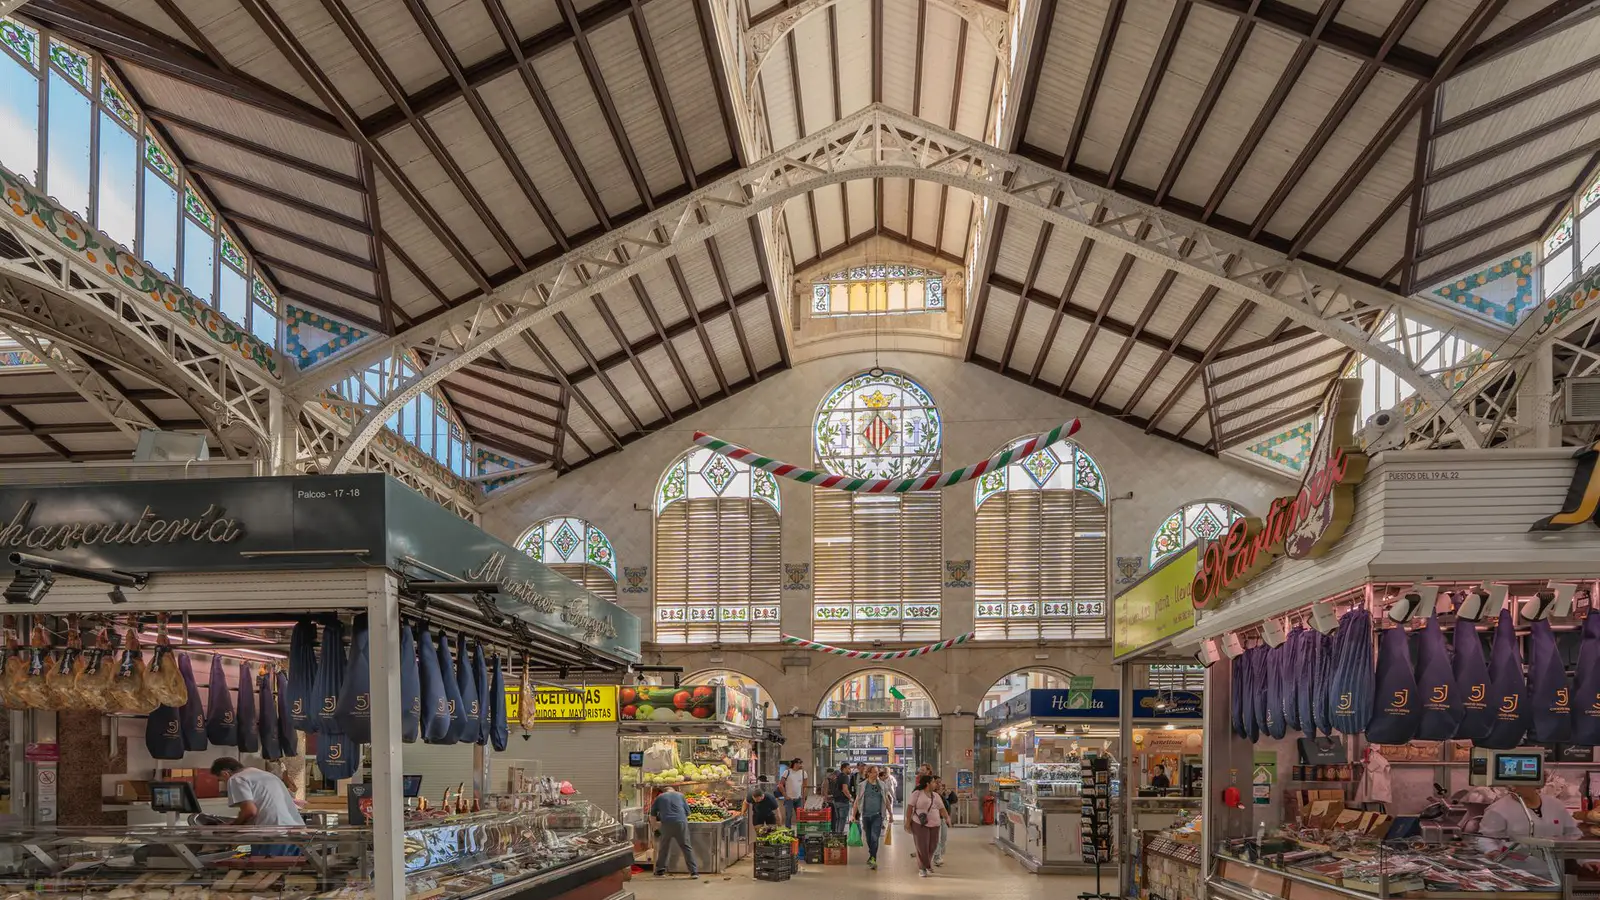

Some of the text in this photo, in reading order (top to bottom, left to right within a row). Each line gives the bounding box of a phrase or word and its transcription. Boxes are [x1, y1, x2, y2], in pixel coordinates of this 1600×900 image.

[1389, 472, 1416, 480] PUESTOS
[1418, 472, 1429, 480] DEL
[1431, 472, 1440, 480] 19
[1450, 471, 1459, 479] 22
[298, 490, 326, 499] Palcos
[334, 489, 344, 498] 17
[0, 500, 241, 548] harcutería
[512, 708, 612, 718] CMIDOR Y MAYORISTAS
